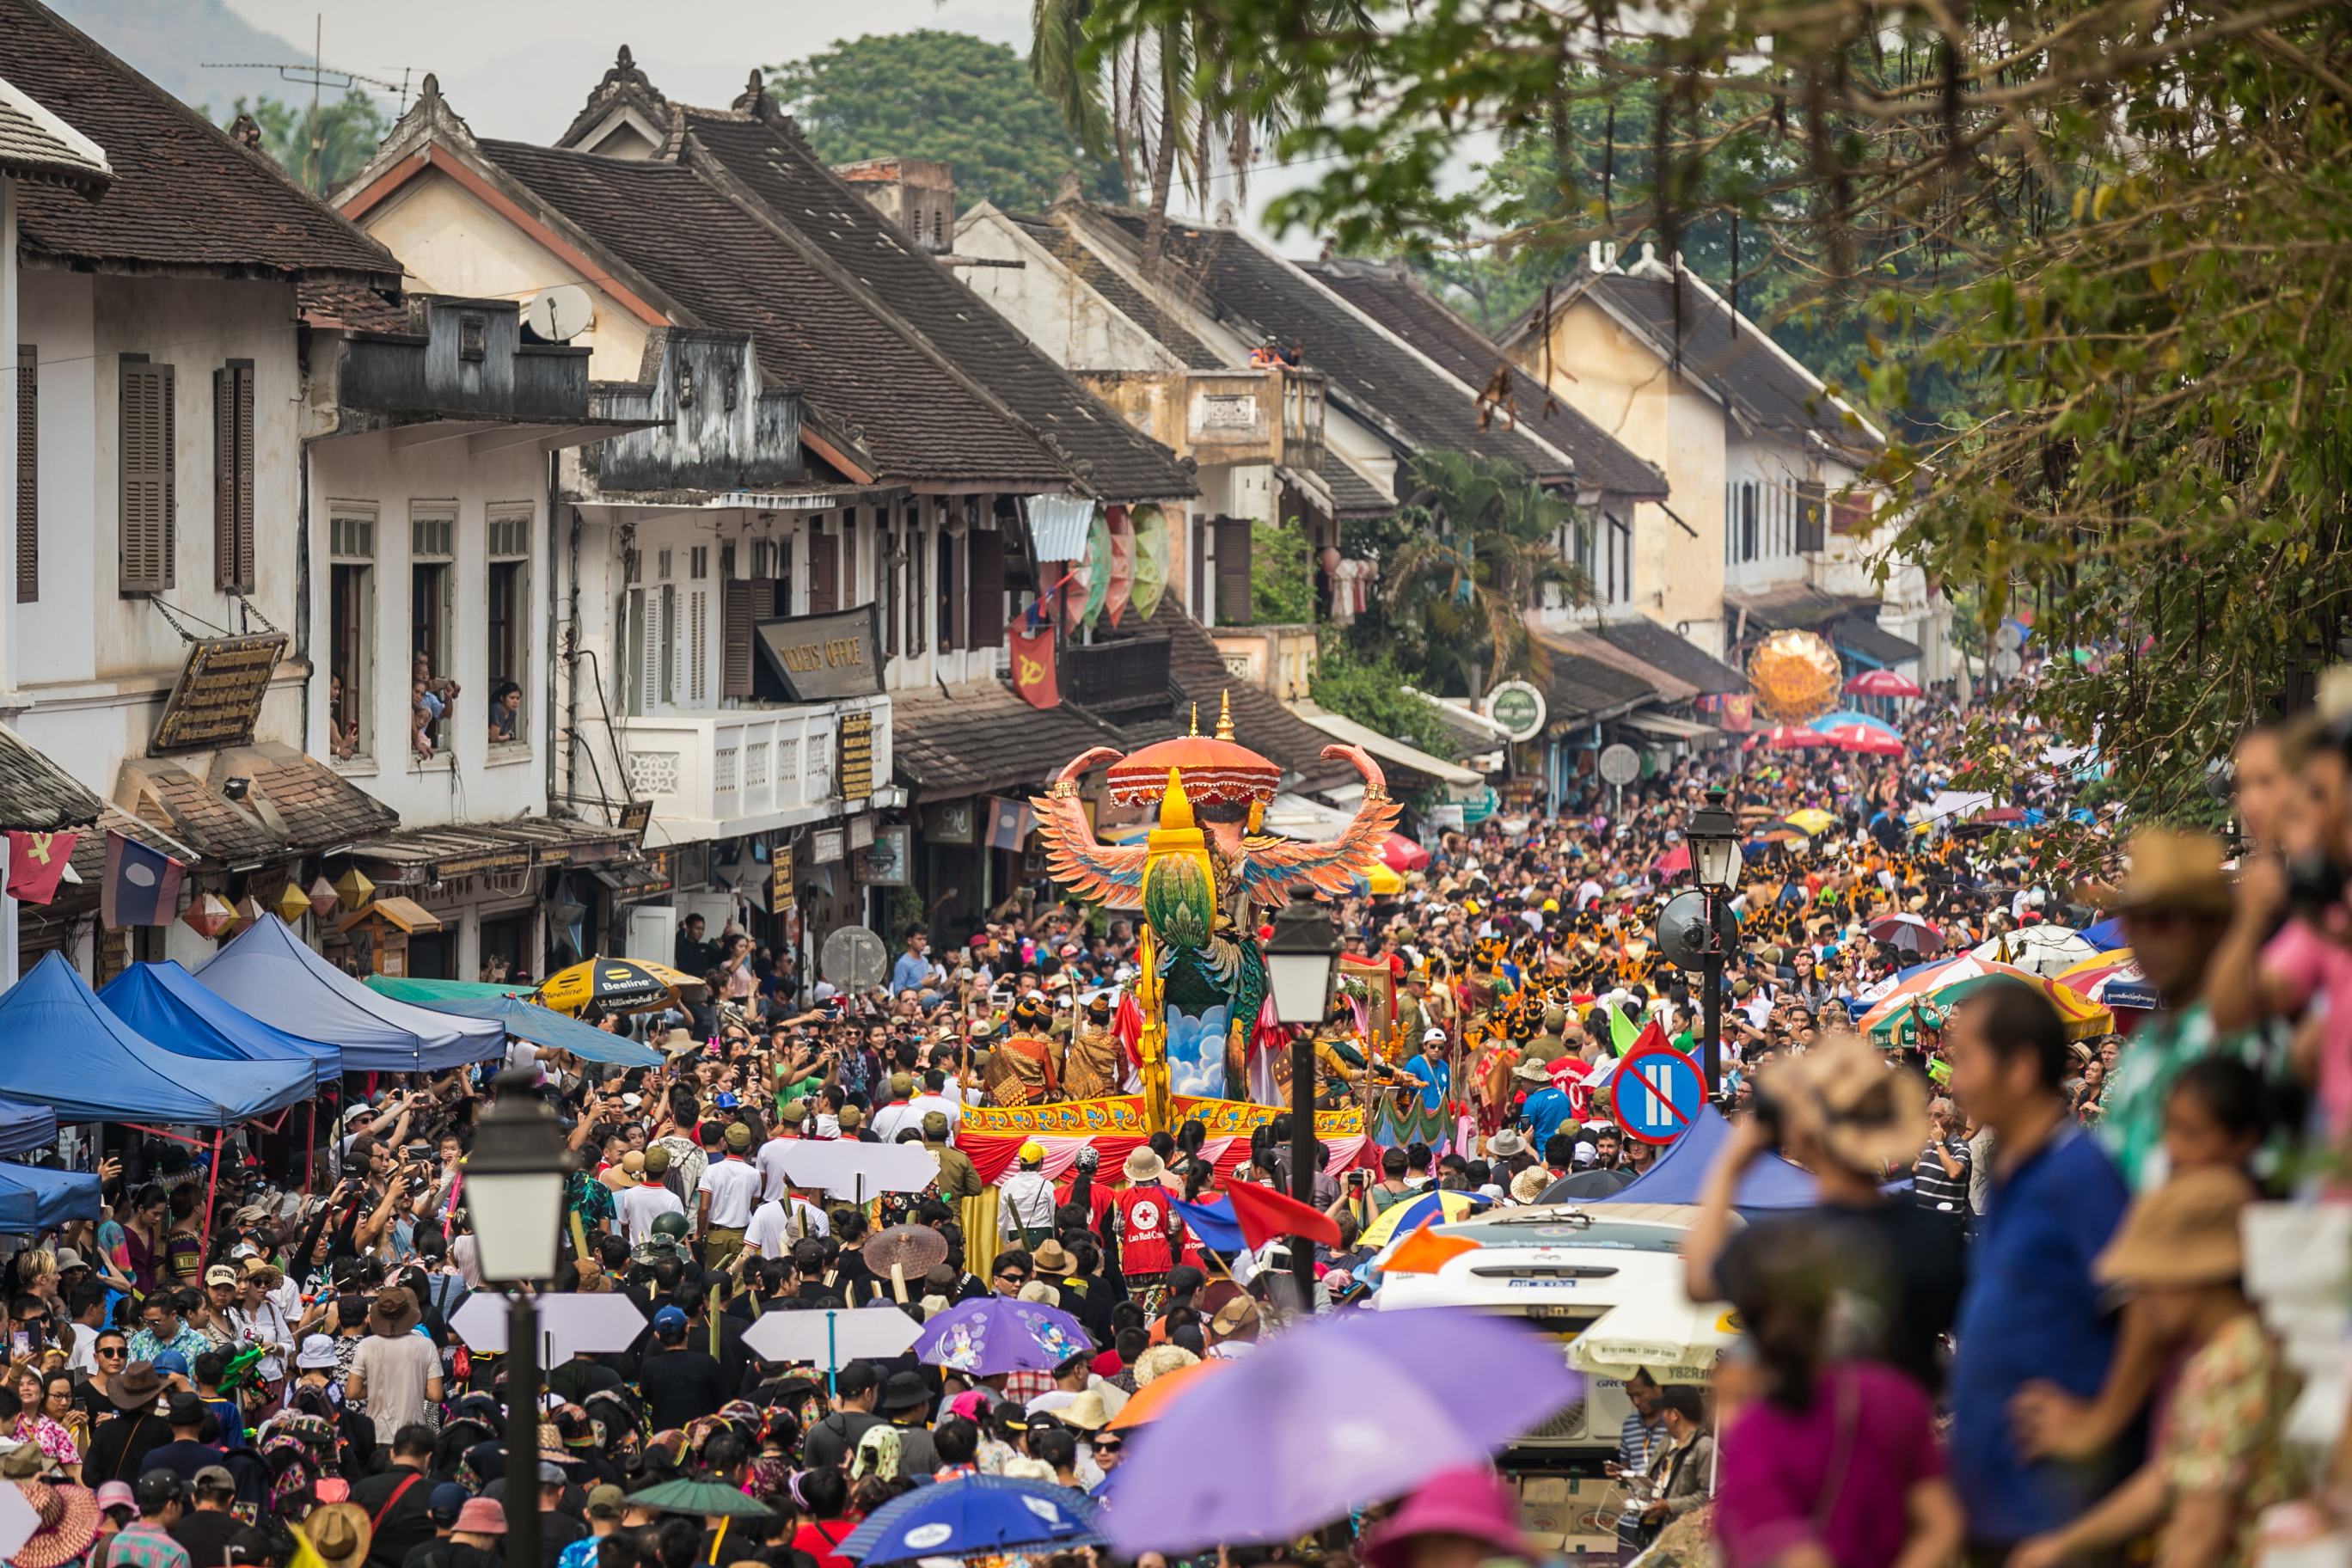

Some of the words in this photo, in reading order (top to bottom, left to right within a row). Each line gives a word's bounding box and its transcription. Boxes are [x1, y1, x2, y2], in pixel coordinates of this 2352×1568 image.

[779, 643, 823, 672] TICKETS
[824, 637, 862, 669] OFFICE
[602, 979, 650, 991] Beeline
[542, 988, 583, 999] Beeline
[1557, 1081, 1583, 1110] 10
[1128, 1234, 1139, 1243] Lao
[1139, 1232, 1151, 1240] Red
[212, 1269, 234, 1280] BOSTON
[1643, 1347, 1659, 1356] CRISP
